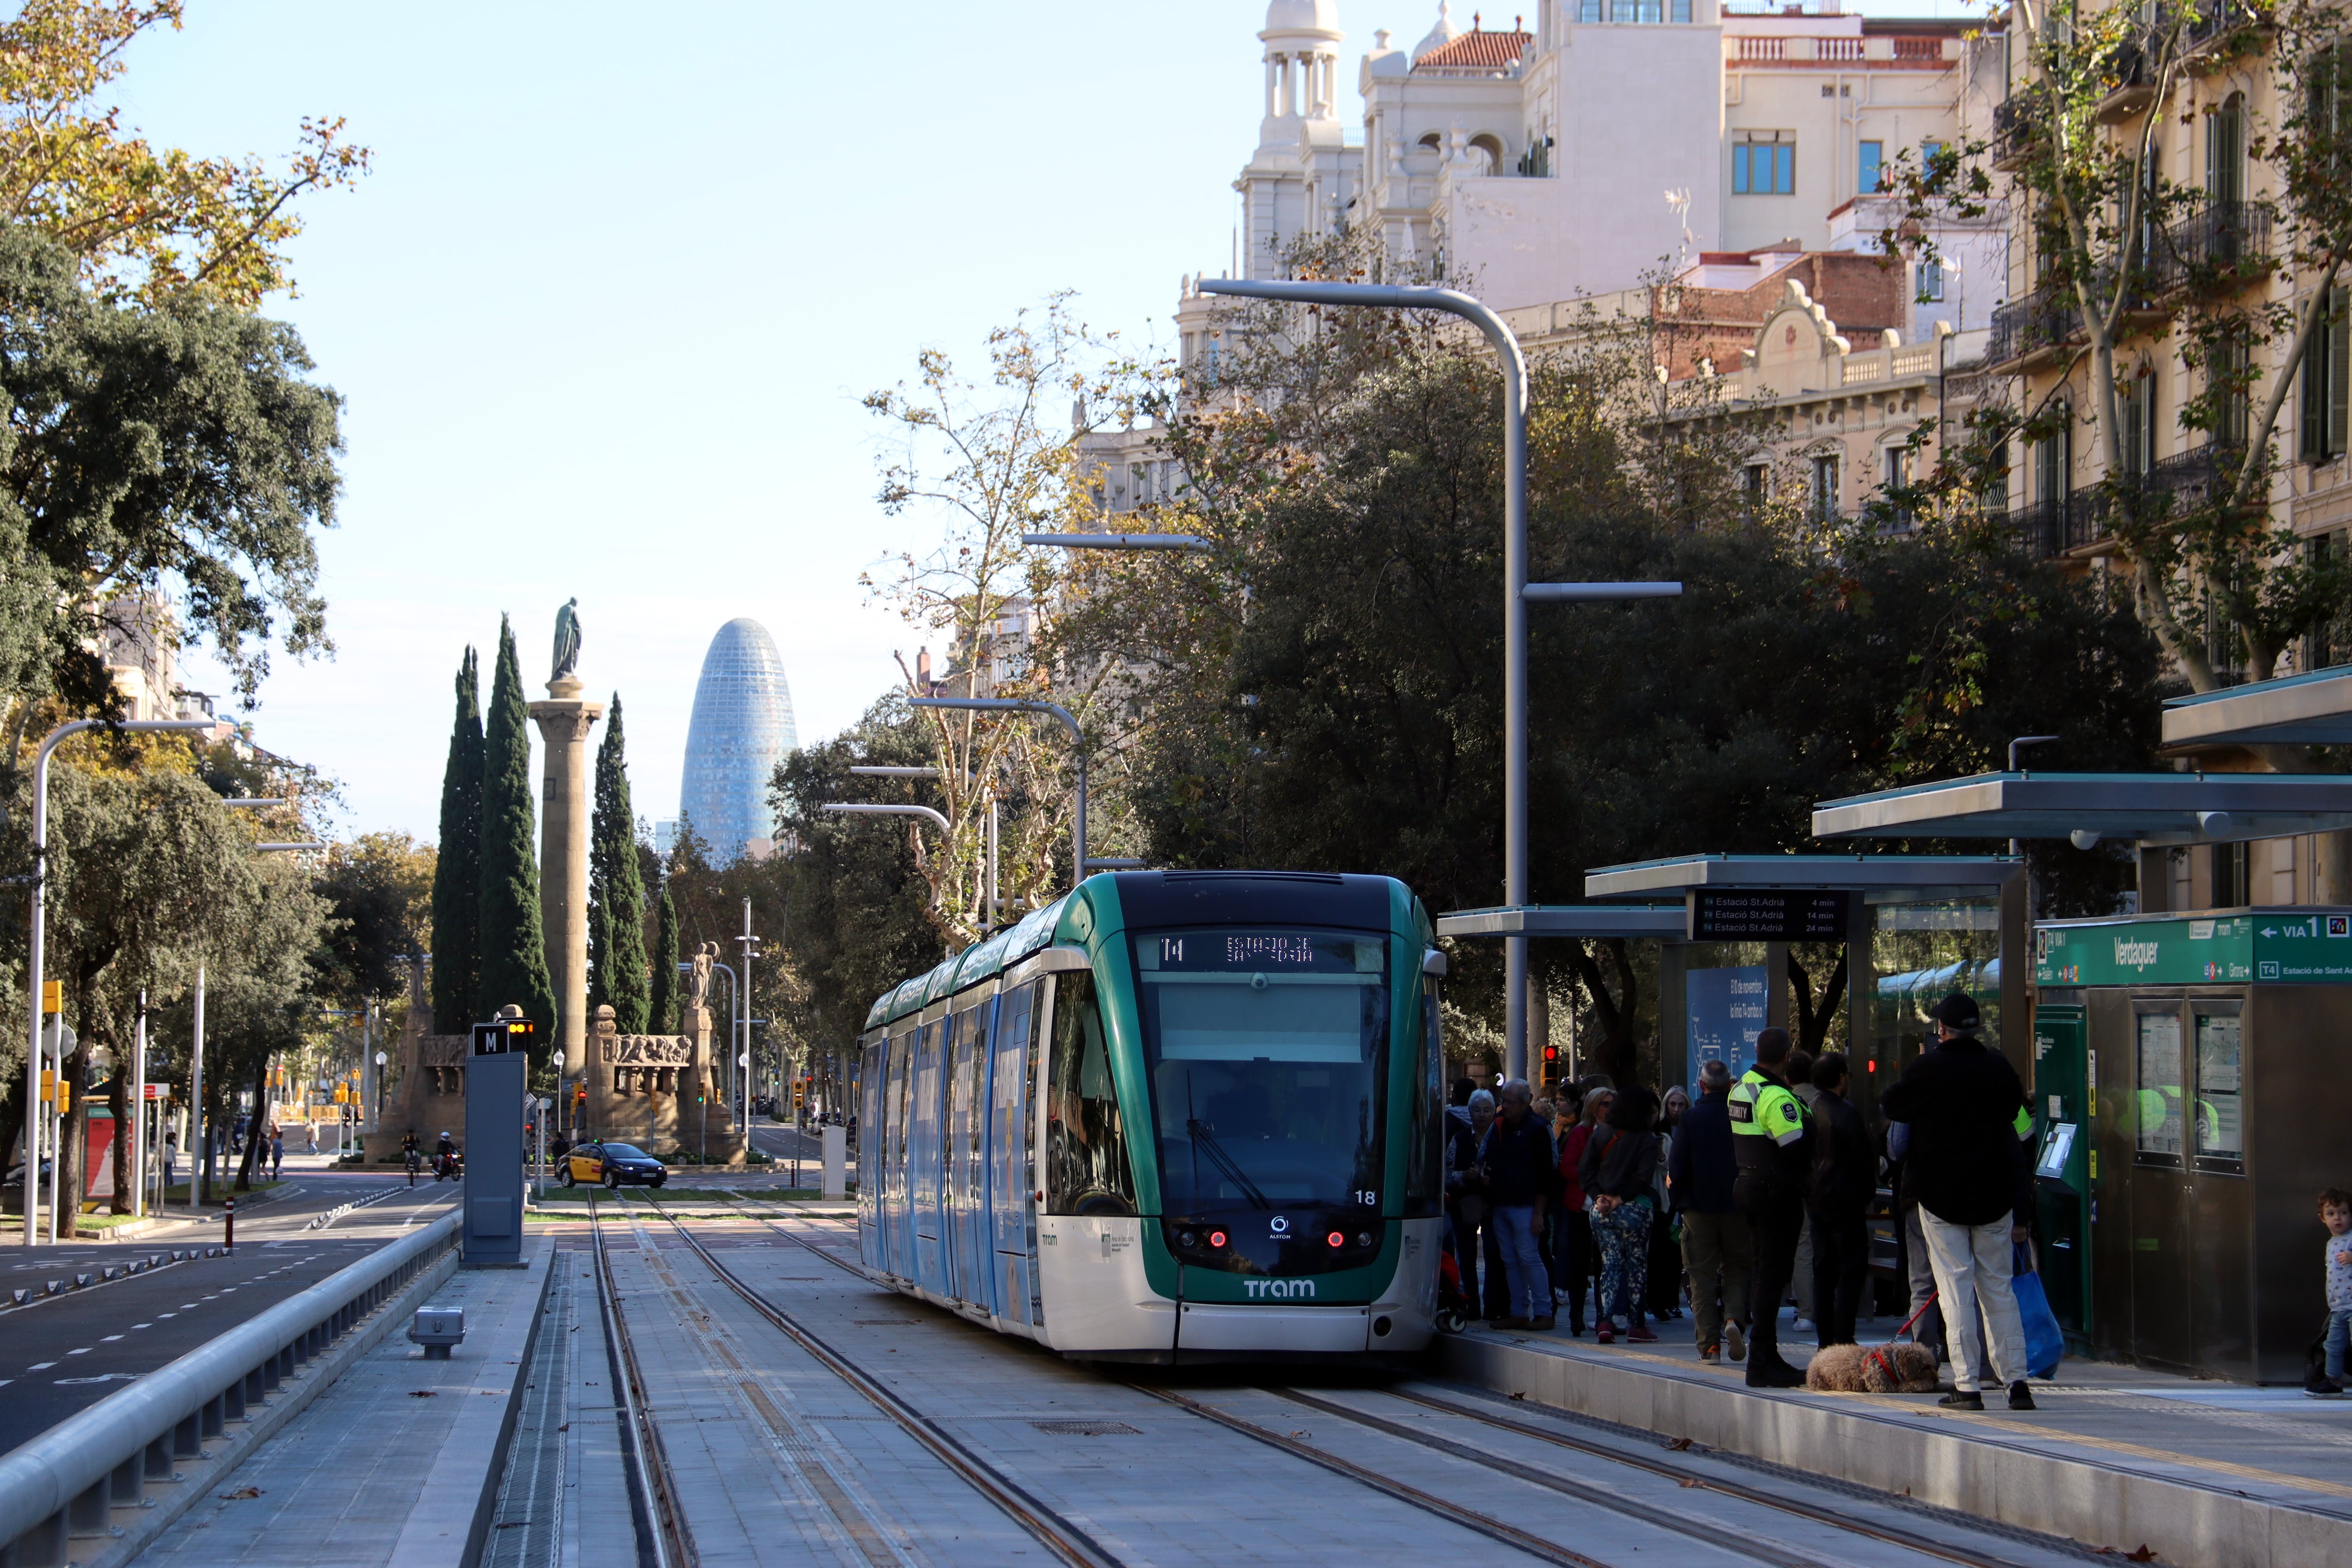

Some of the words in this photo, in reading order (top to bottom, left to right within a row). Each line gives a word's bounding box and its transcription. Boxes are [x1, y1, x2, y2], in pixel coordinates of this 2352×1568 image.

[2283, 926, 2306, 937] VIA
[2306, 916, 2317, 937] 1
[2114, 936, 2159, 972] Verdaguer
[2204, 965, 2209, 976] L5
[2229, 963, 2244, 977] Girona
[2262, 966, 2275, 974] T4
[1743, 979, 1762, 994] novembre
[486, 1032, 496, 1052] M
[1355, 1190, 1375, 1205] 18
